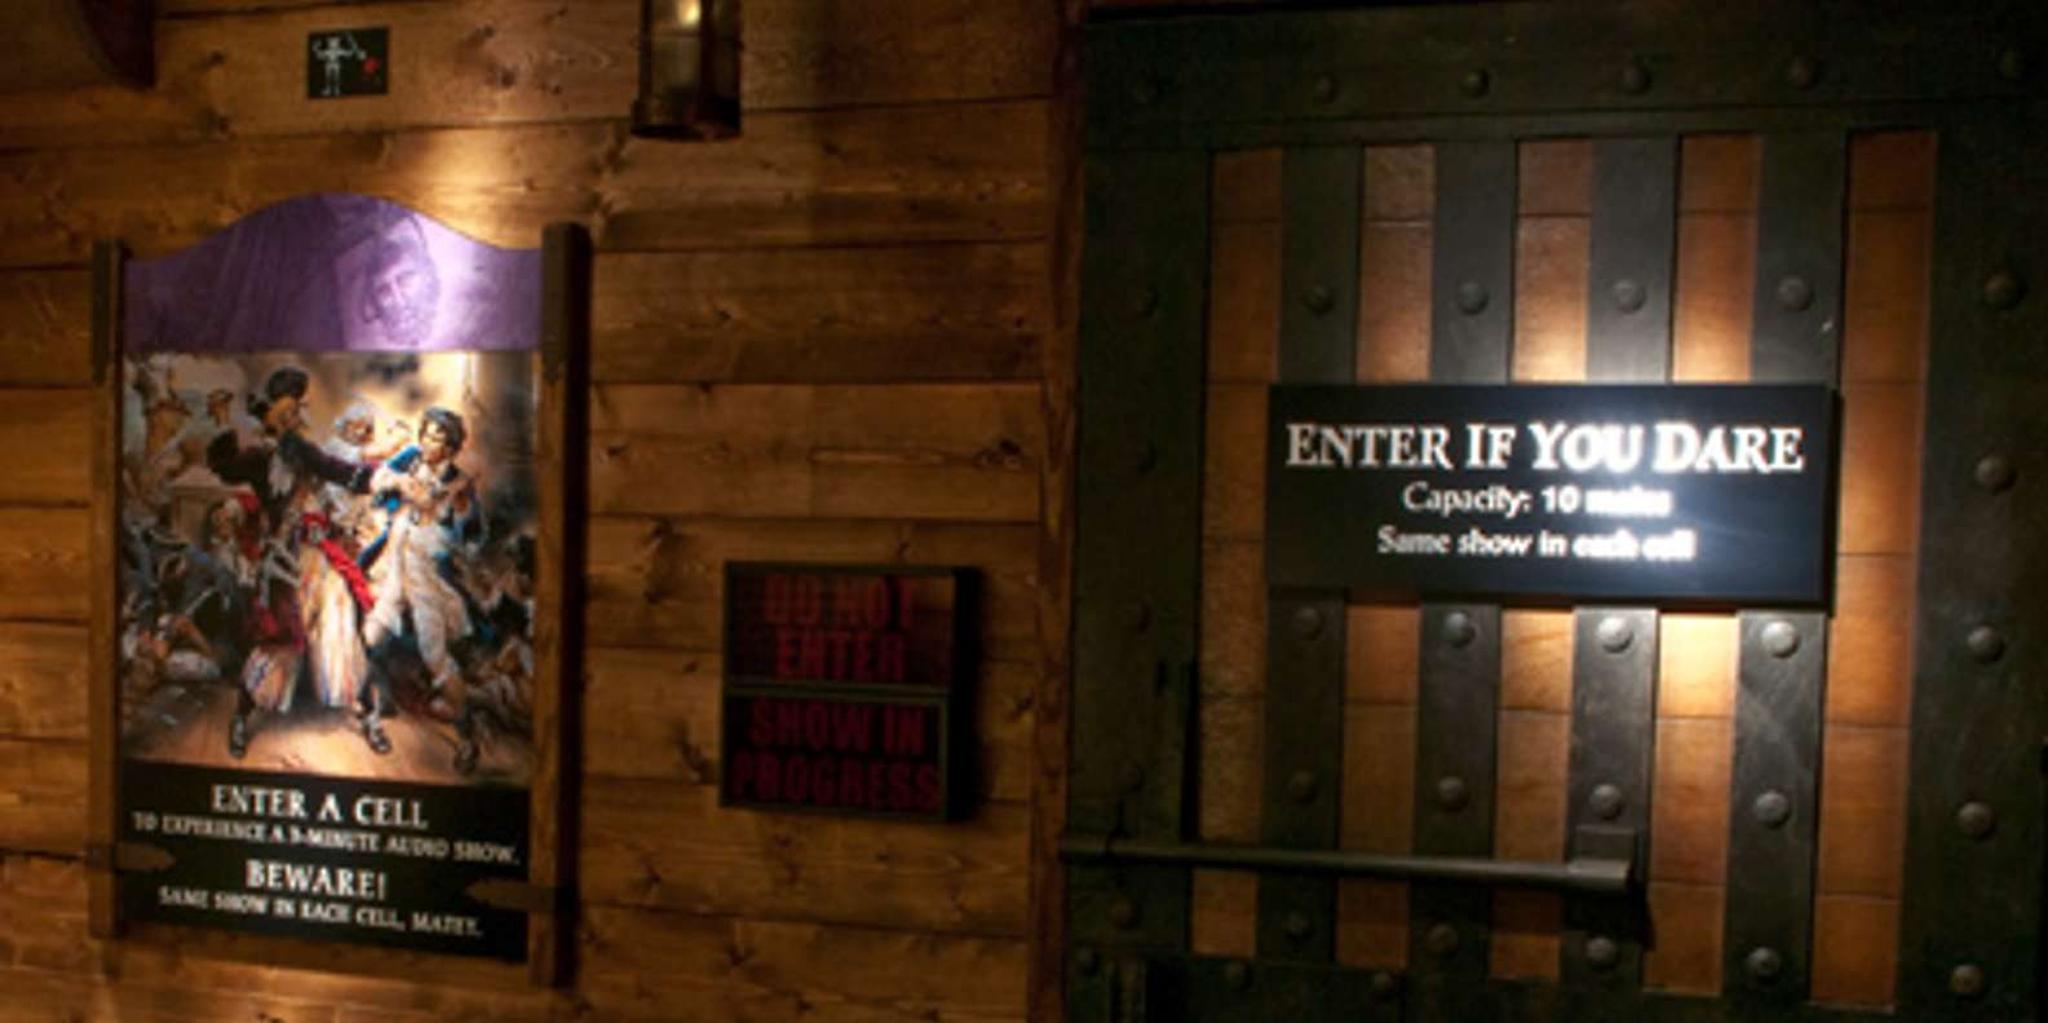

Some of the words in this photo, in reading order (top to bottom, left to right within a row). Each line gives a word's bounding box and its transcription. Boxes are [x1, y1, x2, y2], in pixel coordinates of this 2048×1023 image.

[1285, 422, 1453, 470] ENTER
[1465, 423, 1517, 470] IF
[1527, 421, 1645, 474] YOU
[1651, 421, 1805, 475] DARE
[1402, 482, 1532, 519] Capacity:
[1541, 488, 1579, 516] 10
[1377, 525, 1450, 556] Same
[1457, 529, 1532, 558] show
[1539, 529, 1568, 558] in
[750, 697, 872, 752] SHOW
[732, 751, 938, 811] PROGRESS
[212, 784, 306, 821] ENTER
[318, 794, 342, 822] A
[354, 796, 428, 830] CELL
[132, 811, 157, 831] TO
[162, 817, 264, 842] EXPERIENCE
[269, 828, 285, 843] A
[385, 837, 447, 858] AUDIO
[158, 885, 208, 908] SAME
[213, 892, 268, 914] SHOW
[273, 898, 296, 919] IN
[246, 859, 387, 901] BEWARE!
